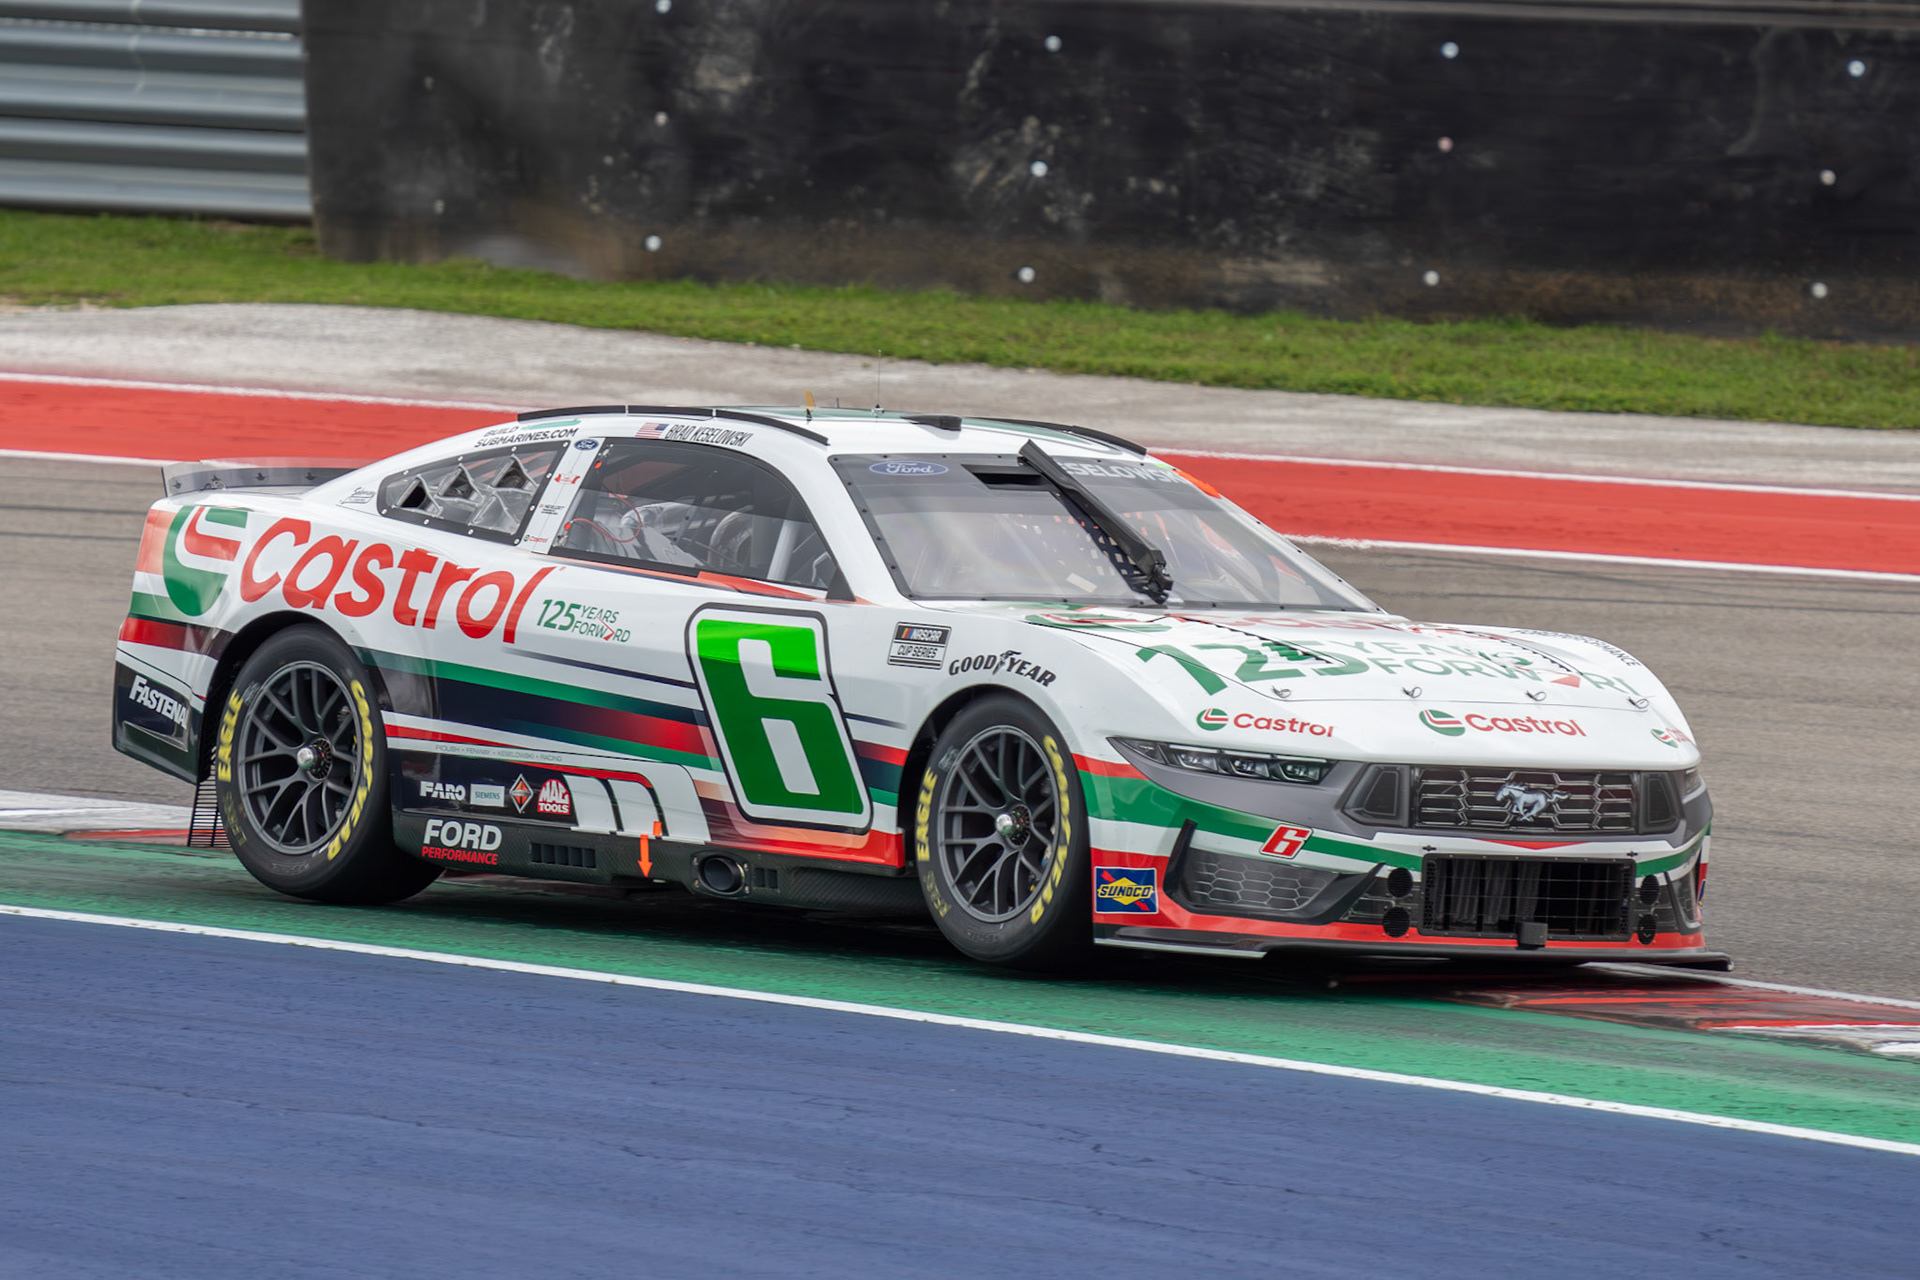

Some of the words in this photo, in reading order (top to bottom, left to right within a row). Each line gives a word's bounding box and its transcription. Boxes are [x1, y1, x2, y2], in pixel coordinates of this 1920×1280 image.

[474, 428, 579, 448] SUBMARINES.COM
[484, 426, 519, 438] BUILD
[665, 424, 691, 440] BRAD
[690, 426, 753, 447] KESELOWSKI
[887, 462, 934, 474] Ford
[240, 517, 558, 644] Castrol
[537, 599, 582, 632] 125
[580, 605, 620, 624] YEARS
[910, 628, 943, 642] NASCAR
[897, 644, 914, 656] CUP
[912, 646, 939, 659] SERIES
[949, 650, 1057, 687] GOODYEAR
[696, 619, 864, 815] 6
[1233, 712, 1335, 737] Castrol
[1465, 713, 1587, 737] Castrol
[217, 688, 244, 783] EAGLE
[419, 781, 466, 801] FARO
[474, 791, 500, 800] SIEMENS
[539, 780, 569, 804] MAC
[538, 802, 569, 814] TOOLS
[916, 767, 938, 862] EAGLE
[423, 818, 503, 851] FORD
[1261, 825, 1311, 857] 6
[421, 846, 499, 866] PERFORMANCE
[1099, 885, 1152, 898] SUNOCO
